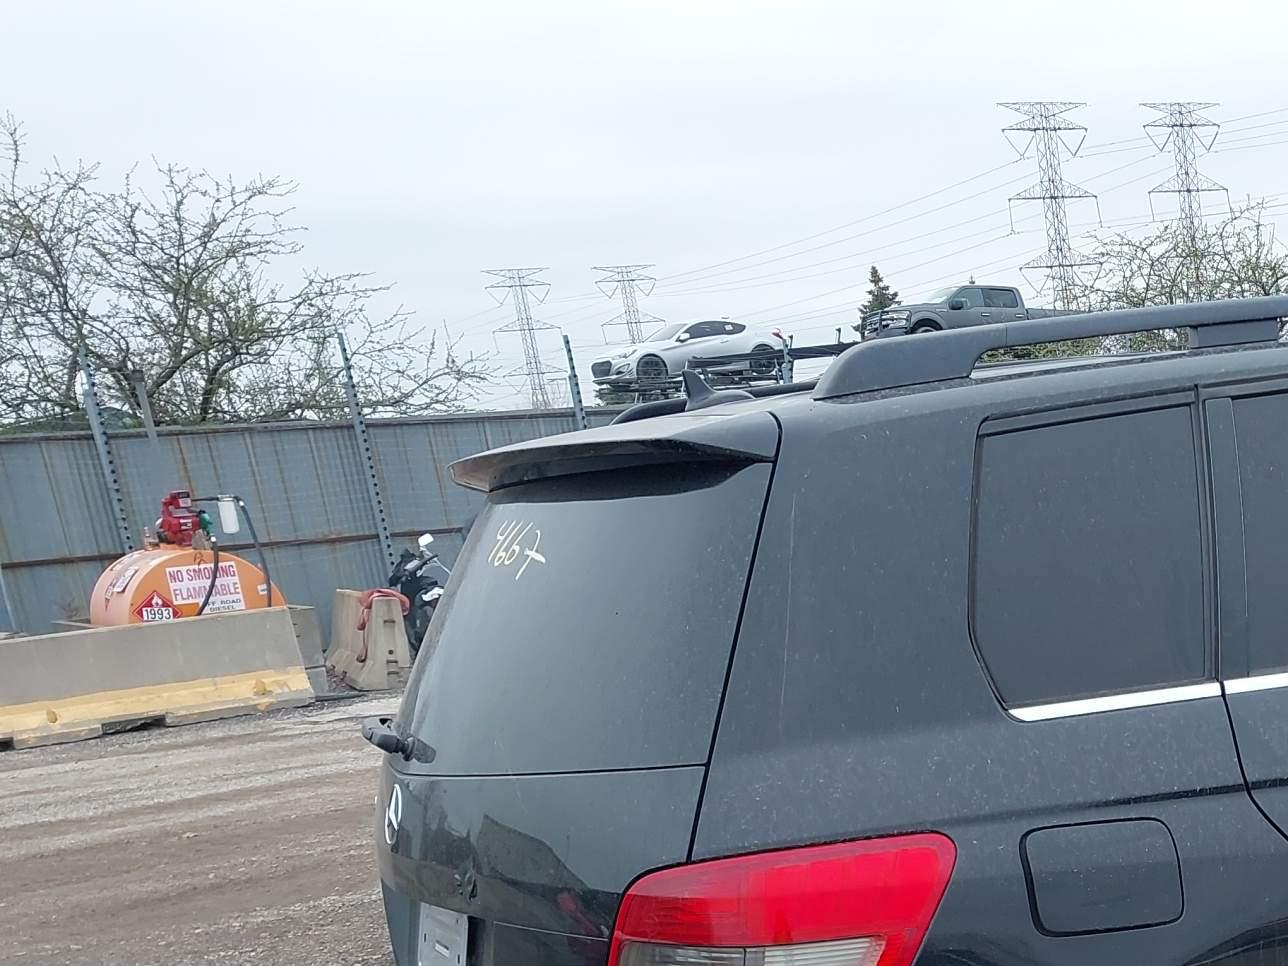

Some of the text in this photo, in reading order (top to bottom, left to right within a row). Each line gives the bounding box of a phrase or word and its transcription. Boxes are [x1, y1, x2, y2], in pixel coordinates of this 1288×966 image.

[487, 519, 547, 581] 4667
[168, 564, 237, 584] NO SMOING
[144, 608, 172, 620] 1993
